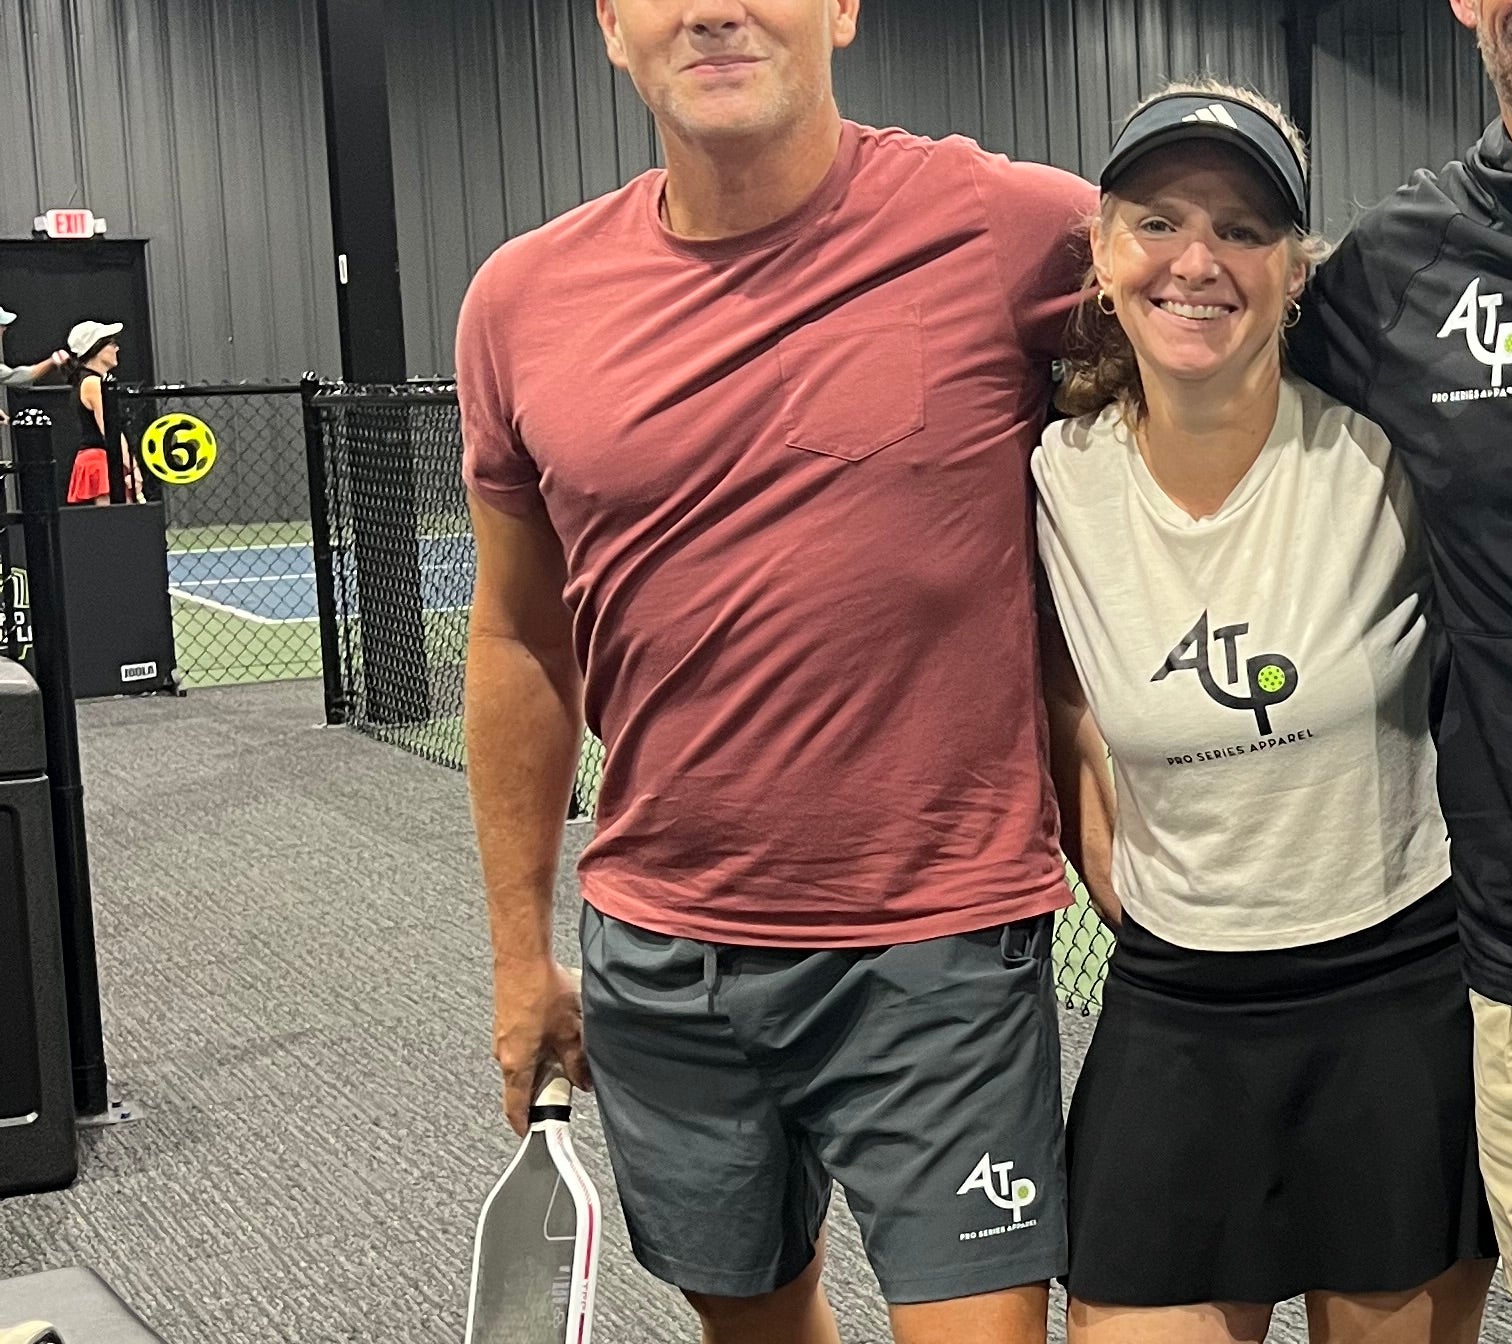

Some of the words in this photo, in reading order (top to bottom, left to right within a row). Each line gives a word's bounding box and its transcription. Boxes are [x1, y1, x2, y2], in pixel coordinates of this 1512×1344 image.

[55, 213, 86, 234] EXIT
[163, 421, 198, 472] 6
[1150, 607, 1299, 737] ATP
[1166, 754, 1193, 766] PRO
[1196, 745, 1245, 763] SERIES
[1249, 728, 1314, 753] APPAREL
[956, 1151, 1036, 1223] ATP
